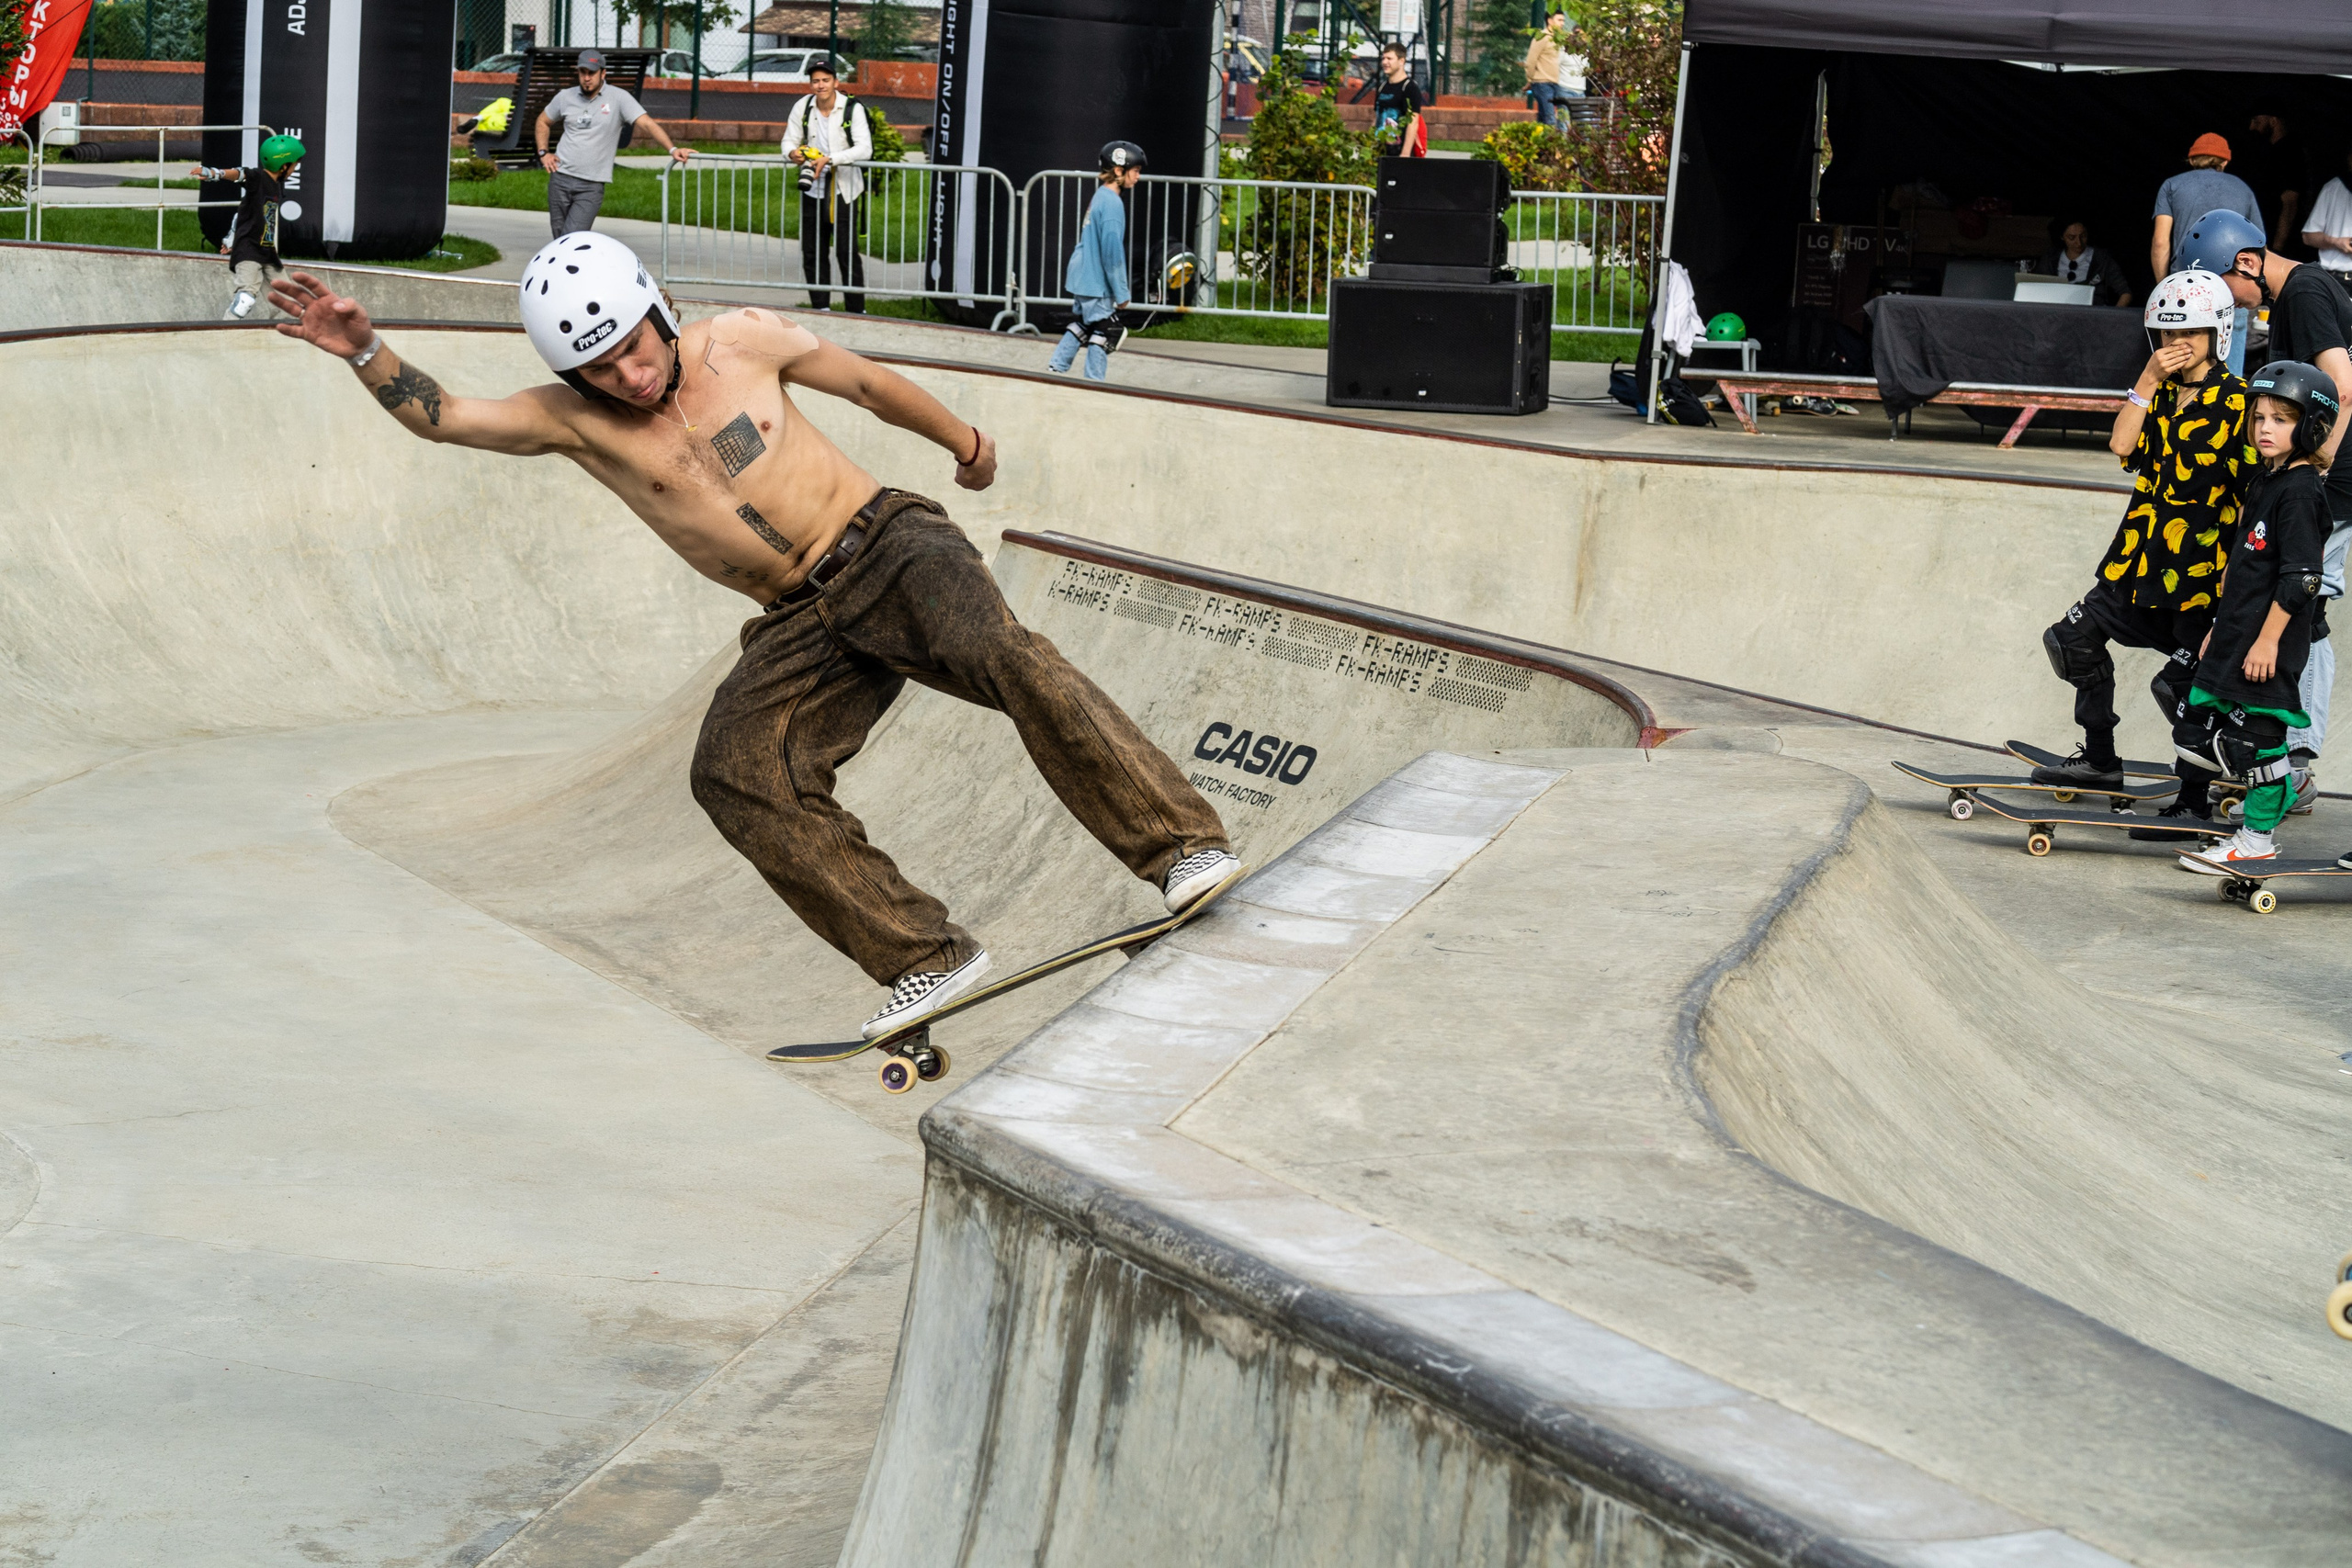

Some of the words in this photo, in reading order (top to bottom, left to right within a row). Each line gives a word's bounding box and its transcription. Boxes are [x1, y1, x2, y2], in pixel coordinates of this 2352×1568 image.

[945, 0, 957, 54] IGHT
[939, 63, 954, 157] ON/OFF
[284, 128, 301, 190] ME
[1807, 234, 1829, 249] LG
[578, 322, 613, 350] Pro-tec
[1063, 560, 1134, 594] FK-RAMPS
[1204, 597, 1283, 633] FK-RAMPS
[1363, 635, 1450, 673] FK-RAMPS
[1179, 614, 1255, 650] FK-RAMPS
[1336, 654, 1422, 693] FK-RAMPS
[1194, 721, 1317, 785] CASIO
[1189, 772, 1227, 795] WATCH
[1224, 784, 1277, 809] FACTORY
